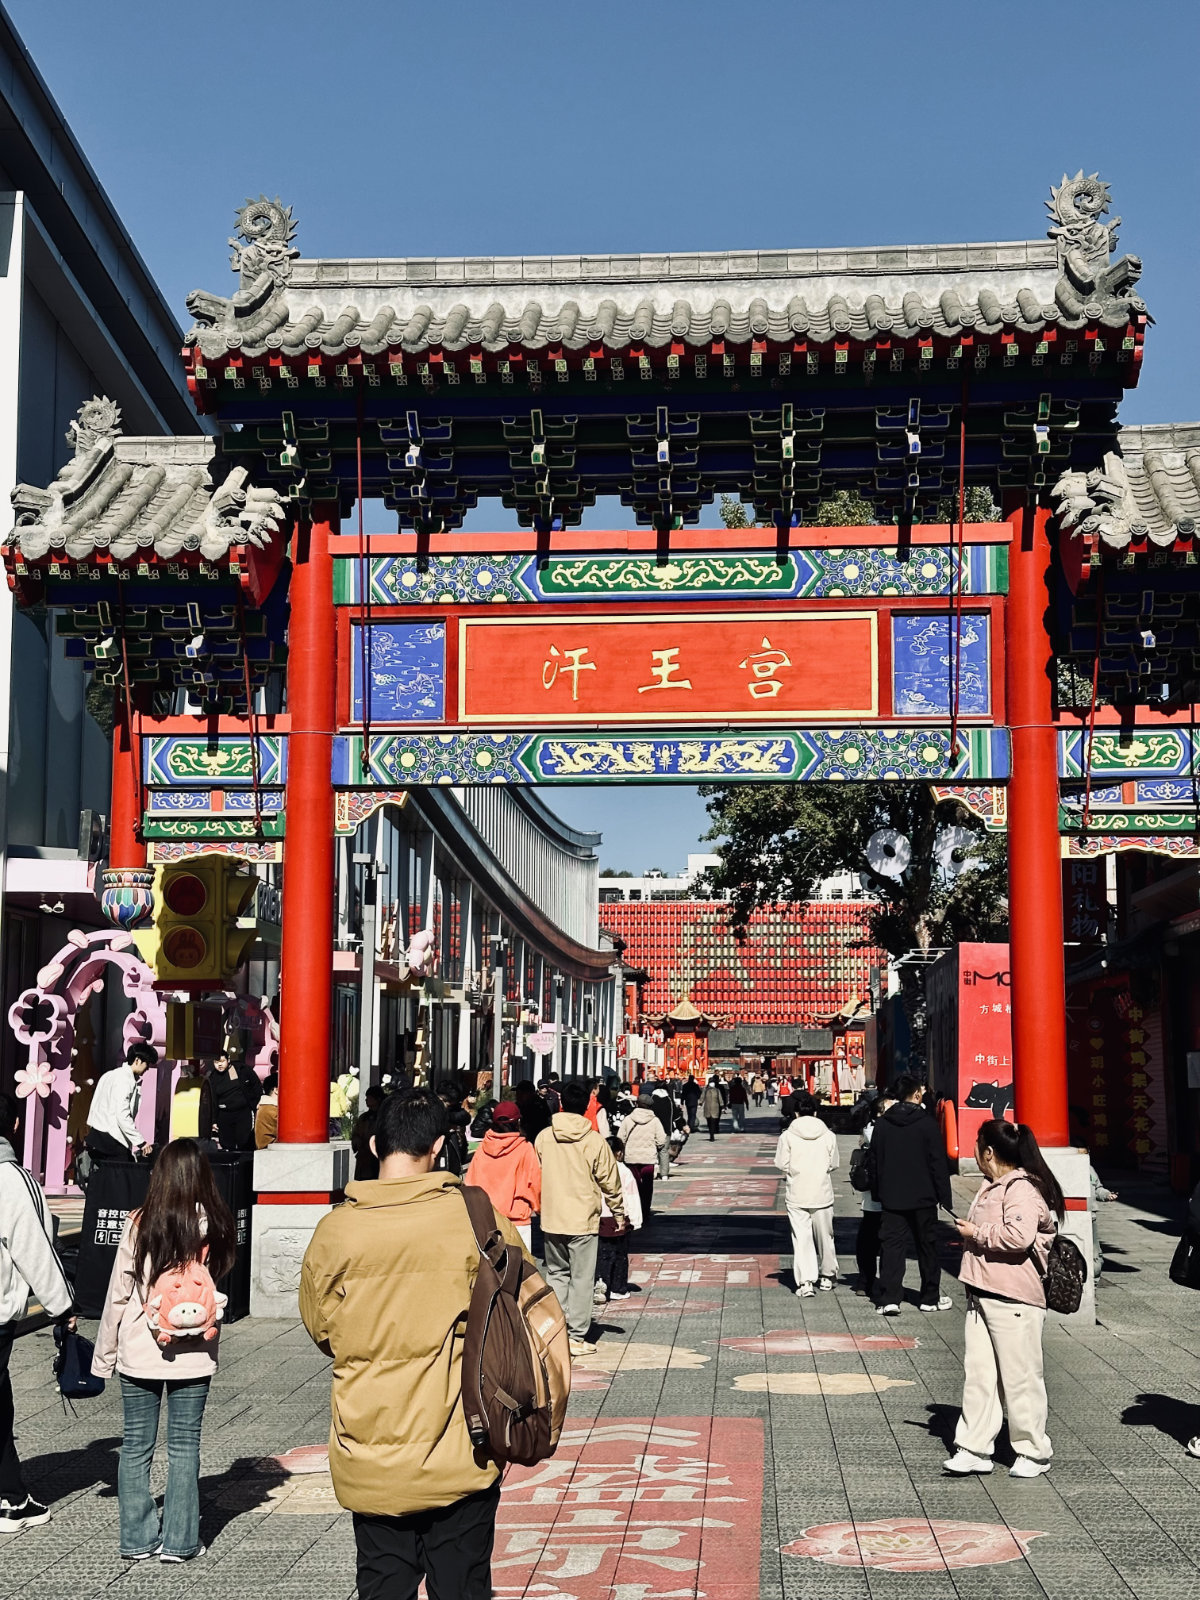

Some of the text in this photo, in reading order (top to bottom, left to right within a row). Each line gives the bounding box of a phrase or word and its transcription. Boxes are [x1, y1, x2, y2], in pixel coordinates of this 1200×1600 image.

[542, 635, 793, 701] 汗王宫
[975, 1052, 1010, 1067] 中街上
